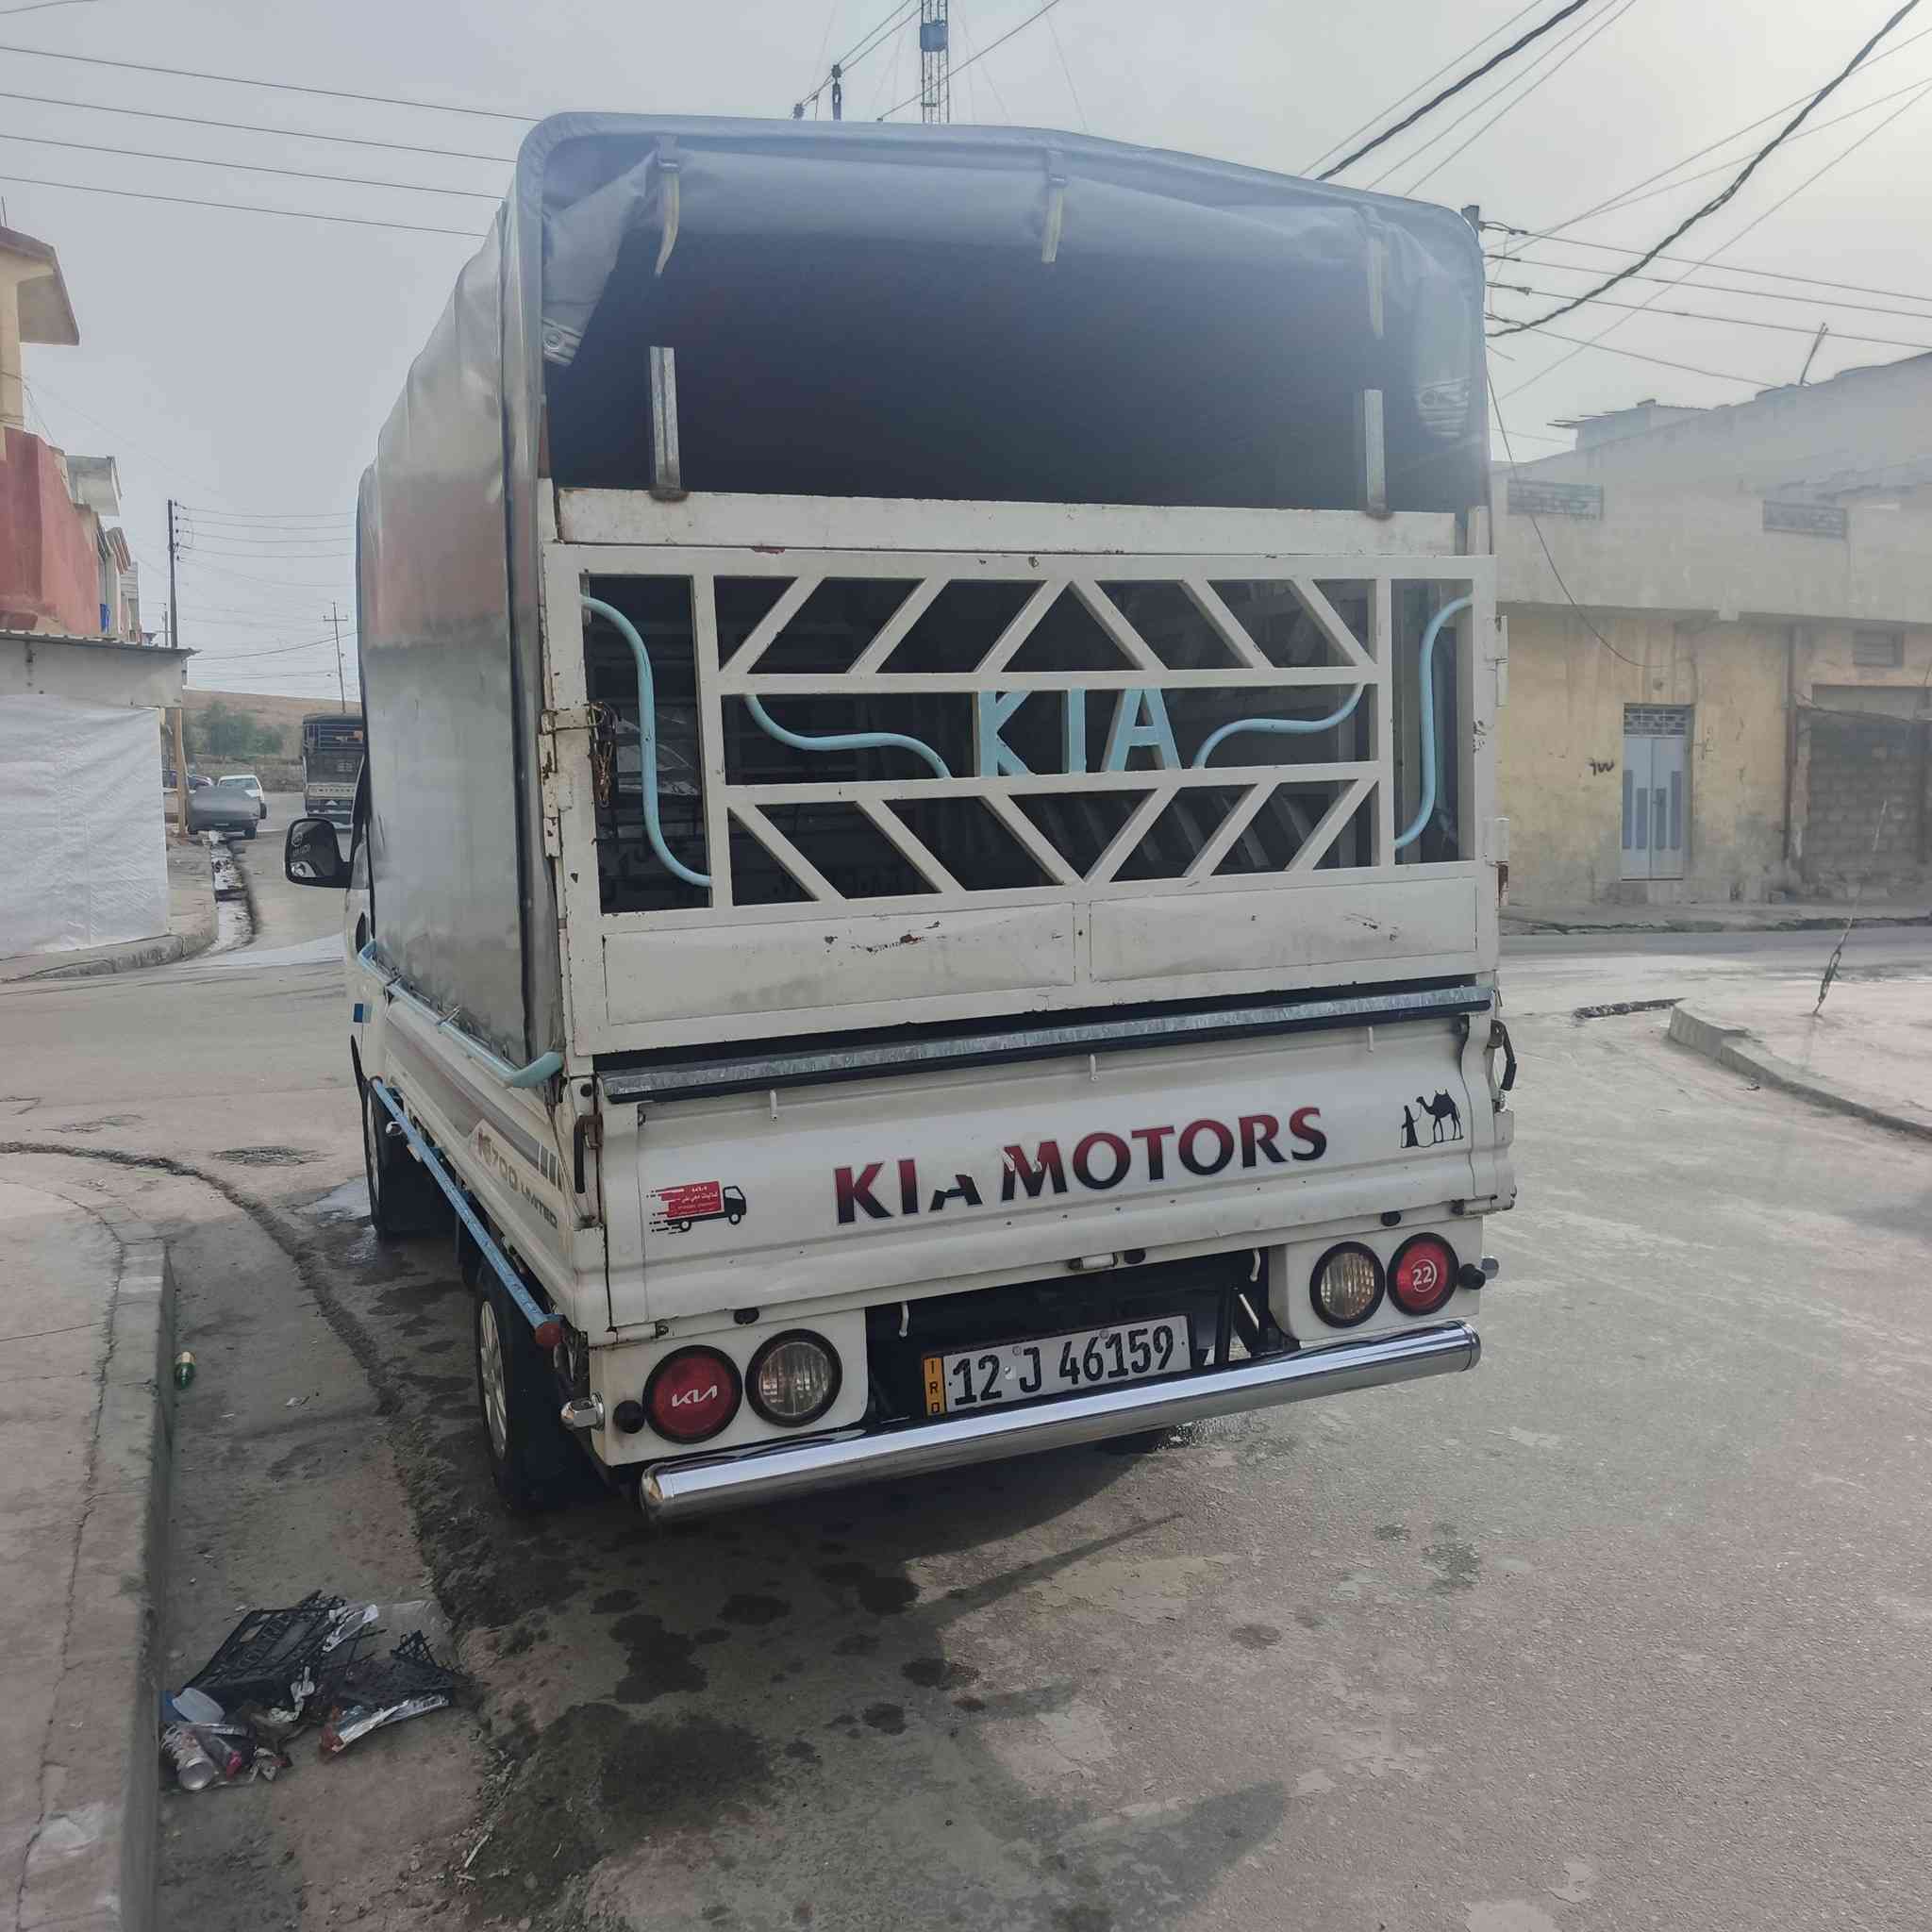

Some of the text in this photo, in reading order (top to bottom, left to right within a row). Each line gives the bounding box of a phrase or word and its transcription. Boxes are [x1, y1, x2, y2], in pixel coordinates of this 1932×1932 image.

[978, 686, 1182, 778] KIA
[835, 1106, 1328, 1225] KIA MOTORS
[1412, 1265, 1433, 1286] 22
[953, 1324, 1174, 1407] 12 J 46159
